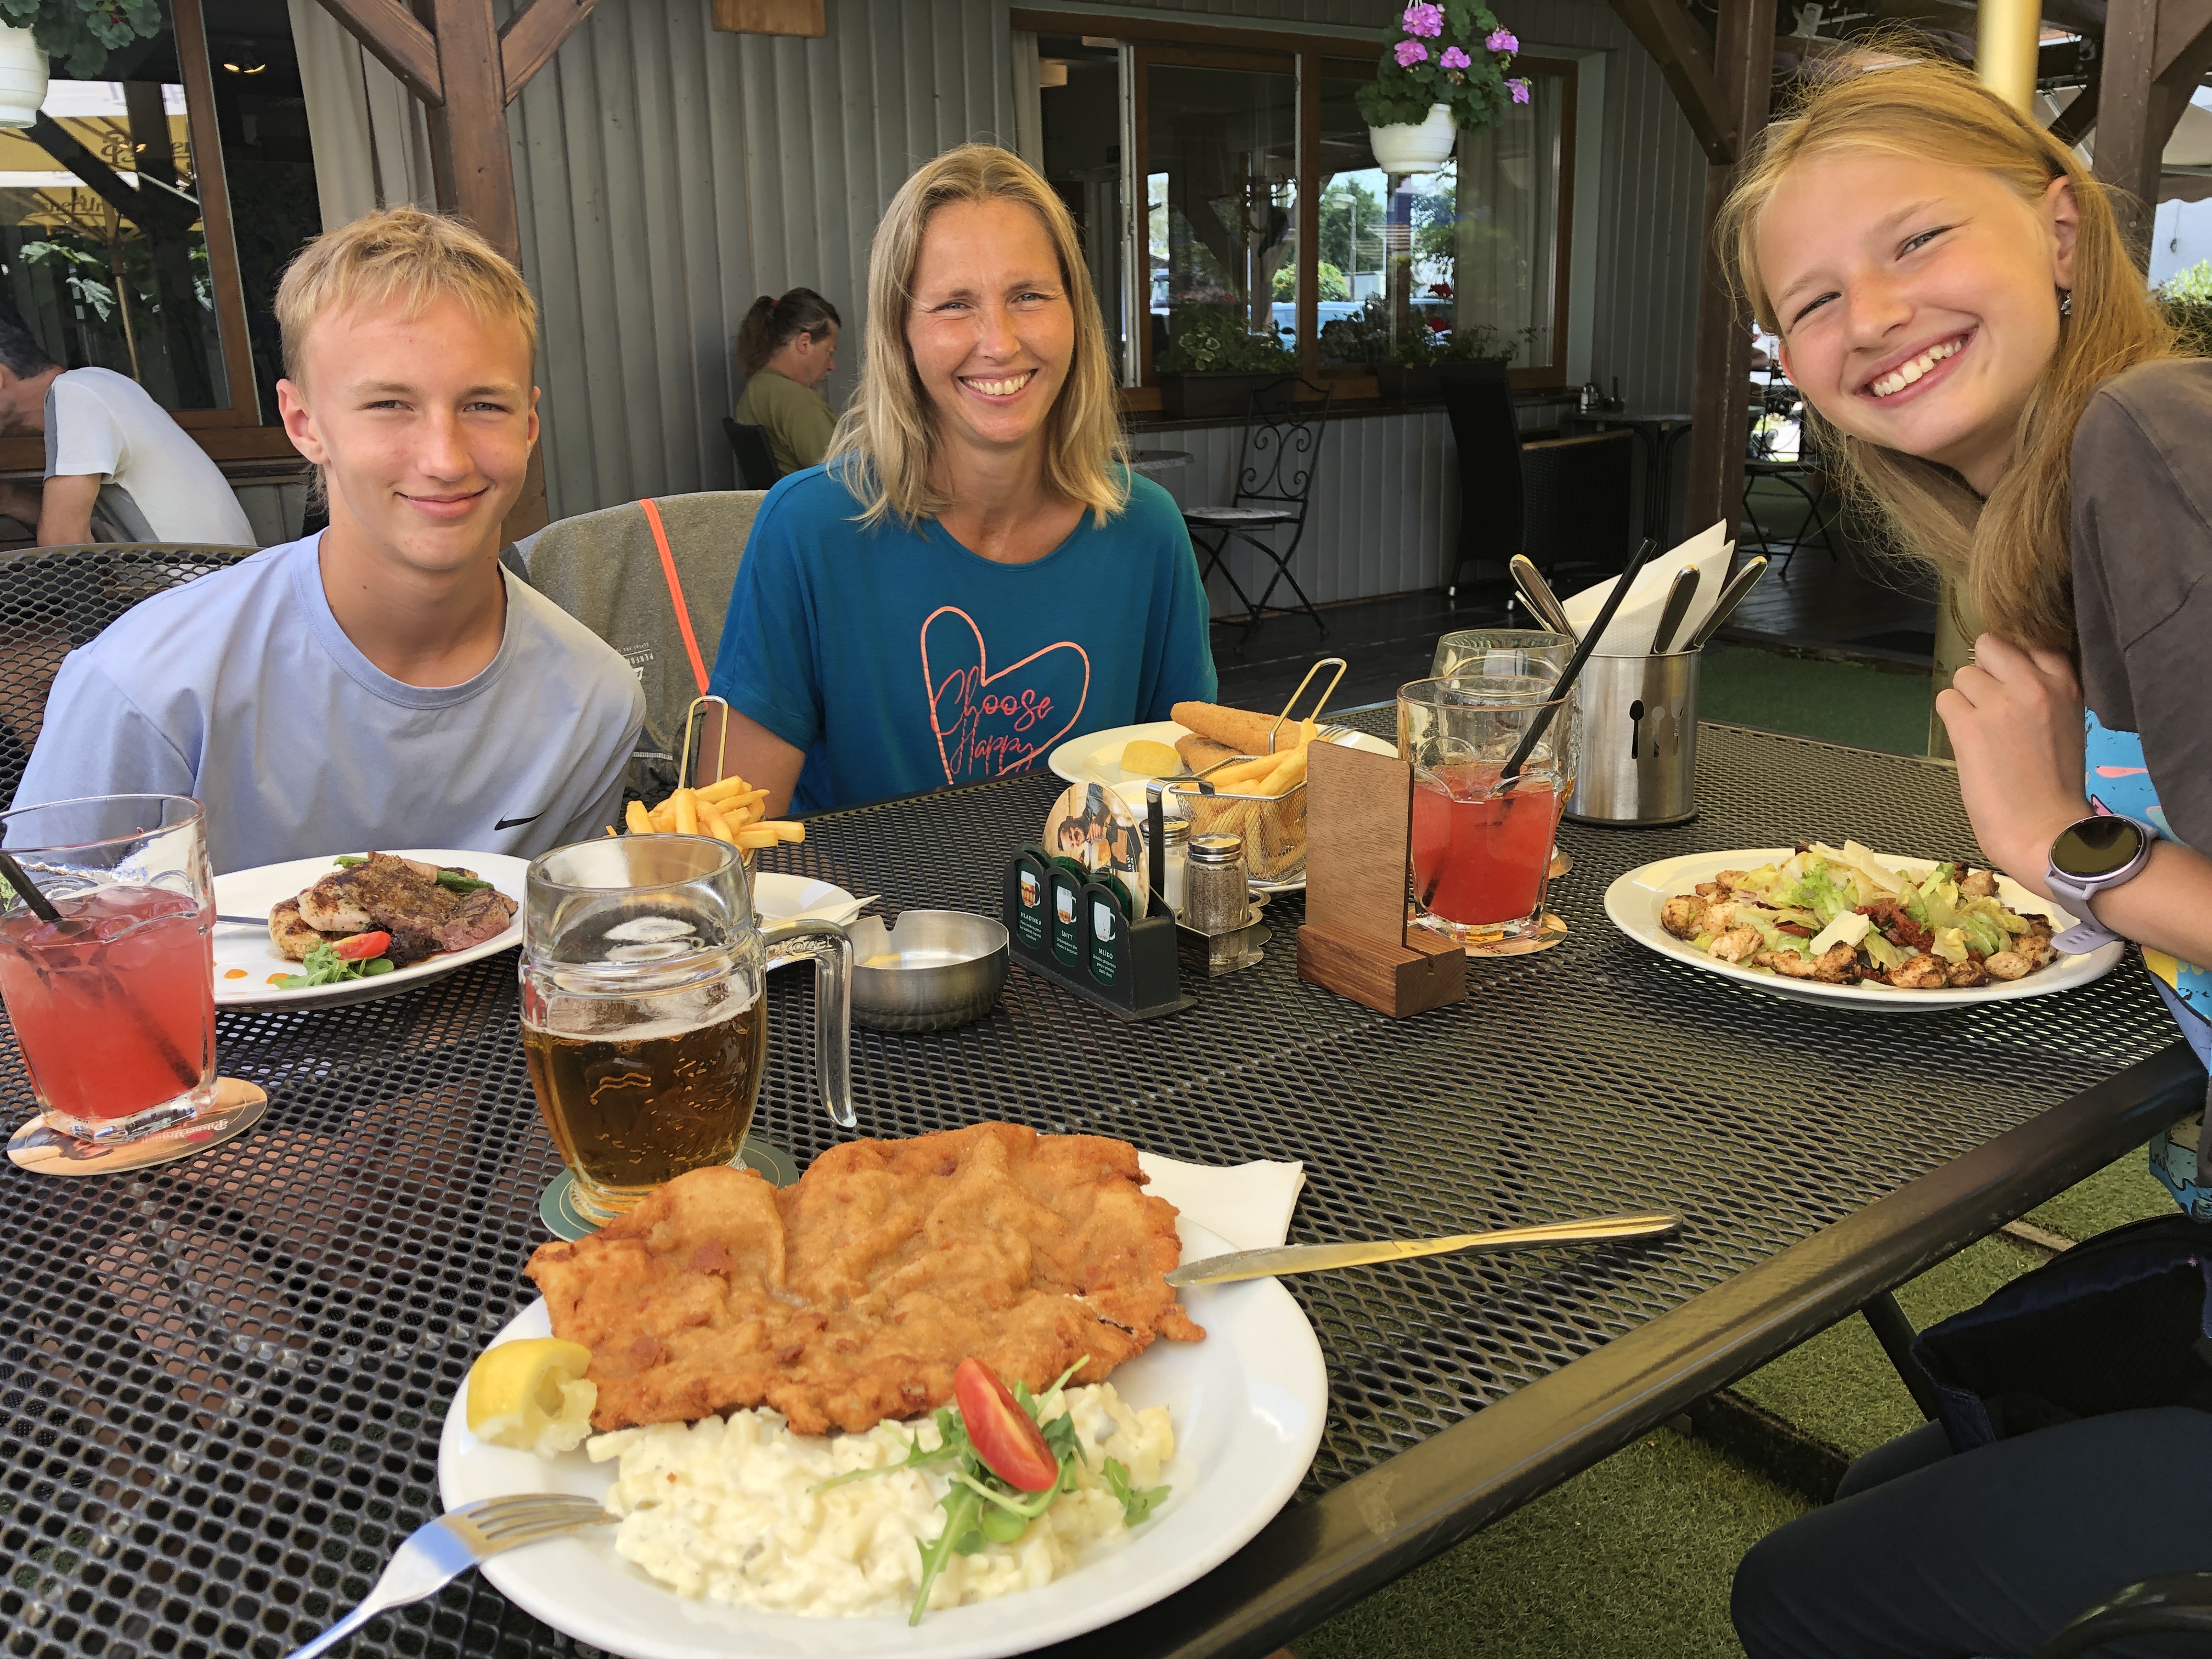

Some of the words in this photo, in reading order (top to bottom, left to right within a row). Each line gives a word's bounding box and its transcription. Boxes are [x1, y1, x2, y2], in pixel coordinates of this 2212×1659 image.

[627, 653, 653, 664] PERFO
[930, 665, 1054, 735] Choose
[950, 714, 1039, 775] Happy
[1020, 911, 1041, 926] HLADINKA
[1098, 947, 1113, 960] MLÍKO
[184, 1119, 229, 1134] Pilsner
[141, 1131, 185, 1143] Urquell
